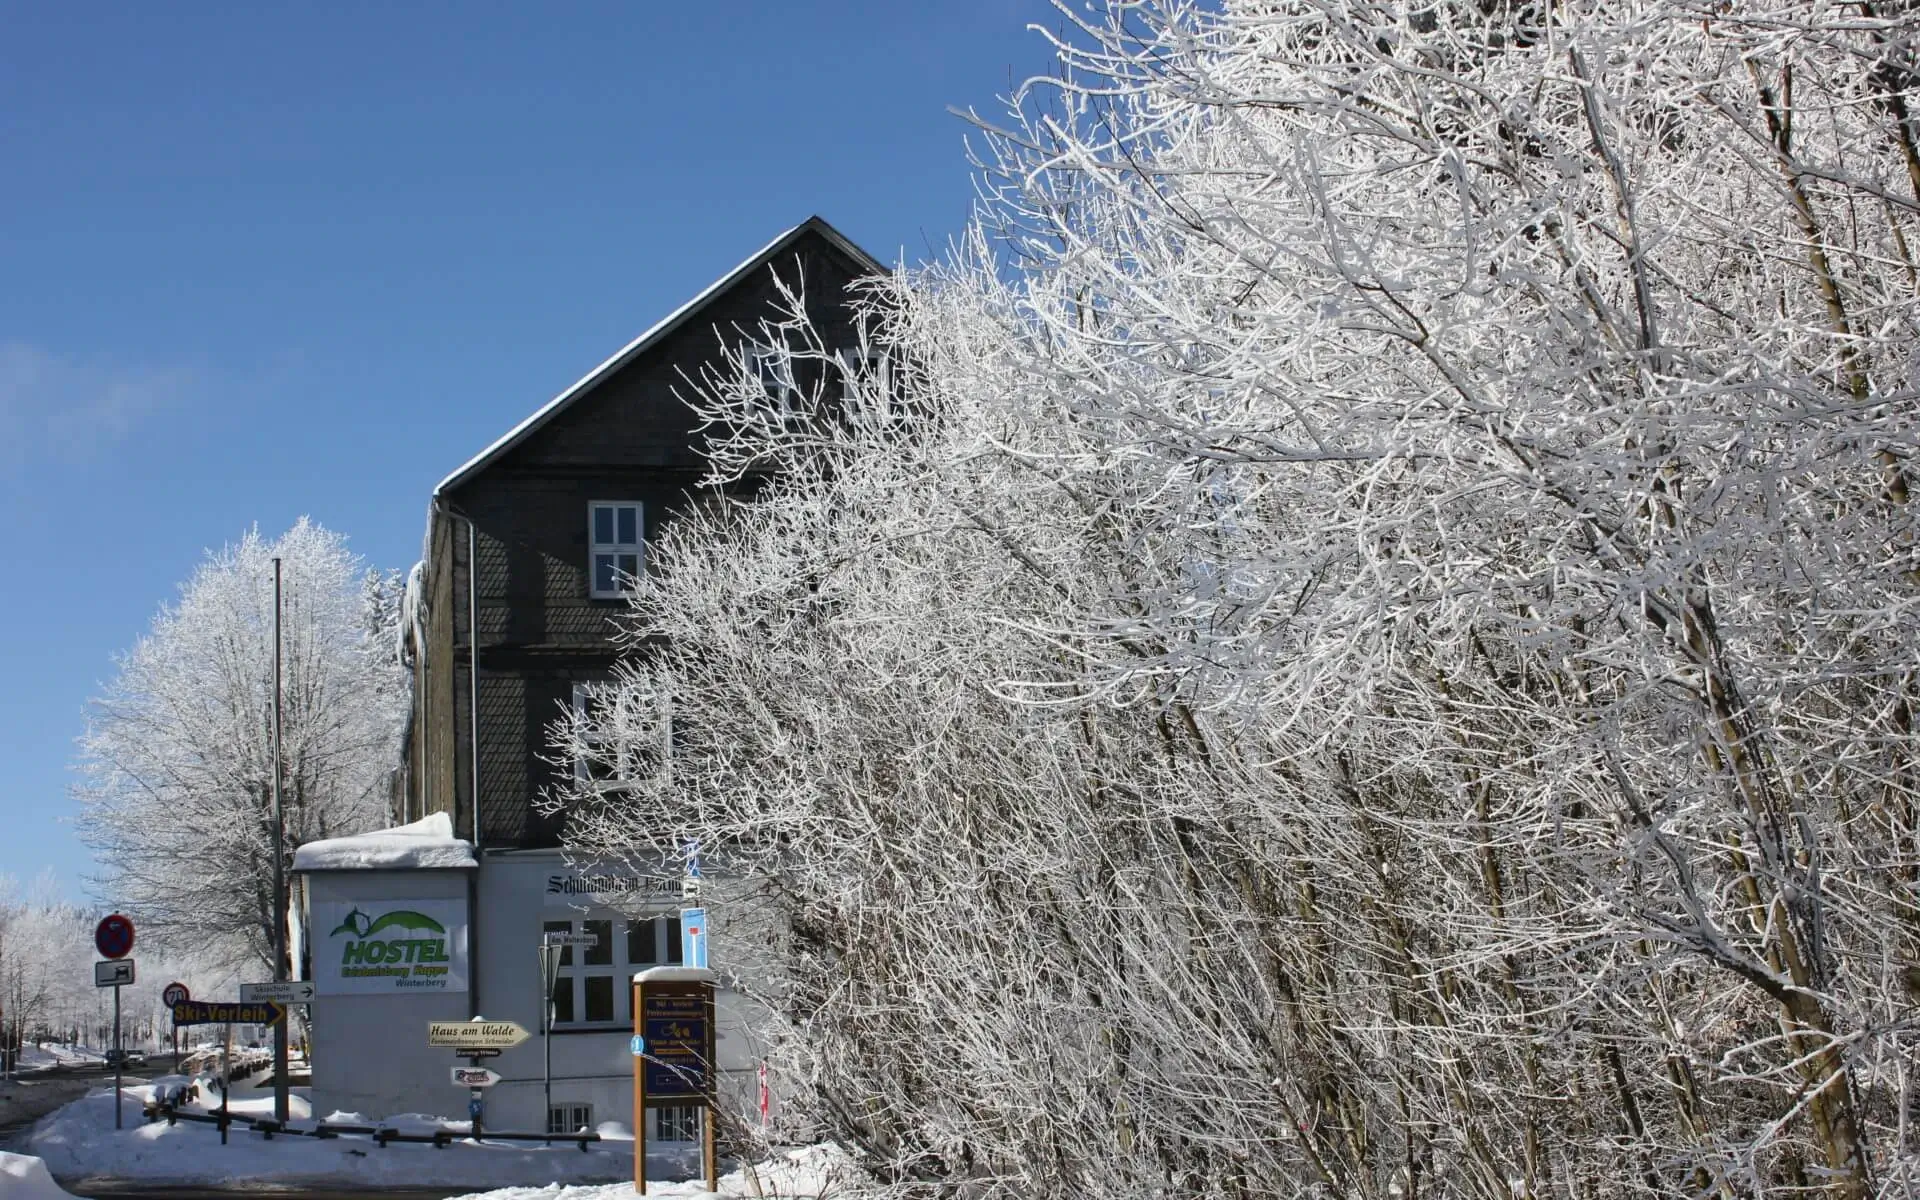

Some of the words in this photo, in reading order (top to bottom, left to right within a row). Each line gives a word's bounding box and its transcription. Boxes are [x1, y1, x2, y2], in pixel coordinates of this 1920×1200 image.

[343, 939, 449, 964] HOSTEL
[395, 977, 447, 988] Winterberg
[174, 1002, 267, 1021] Ski-Verleih
[431, 1025, 458, 1037] Haus
[461, 1027, 478, 1036] am
[481, 1024, 515, 1036] Walde
